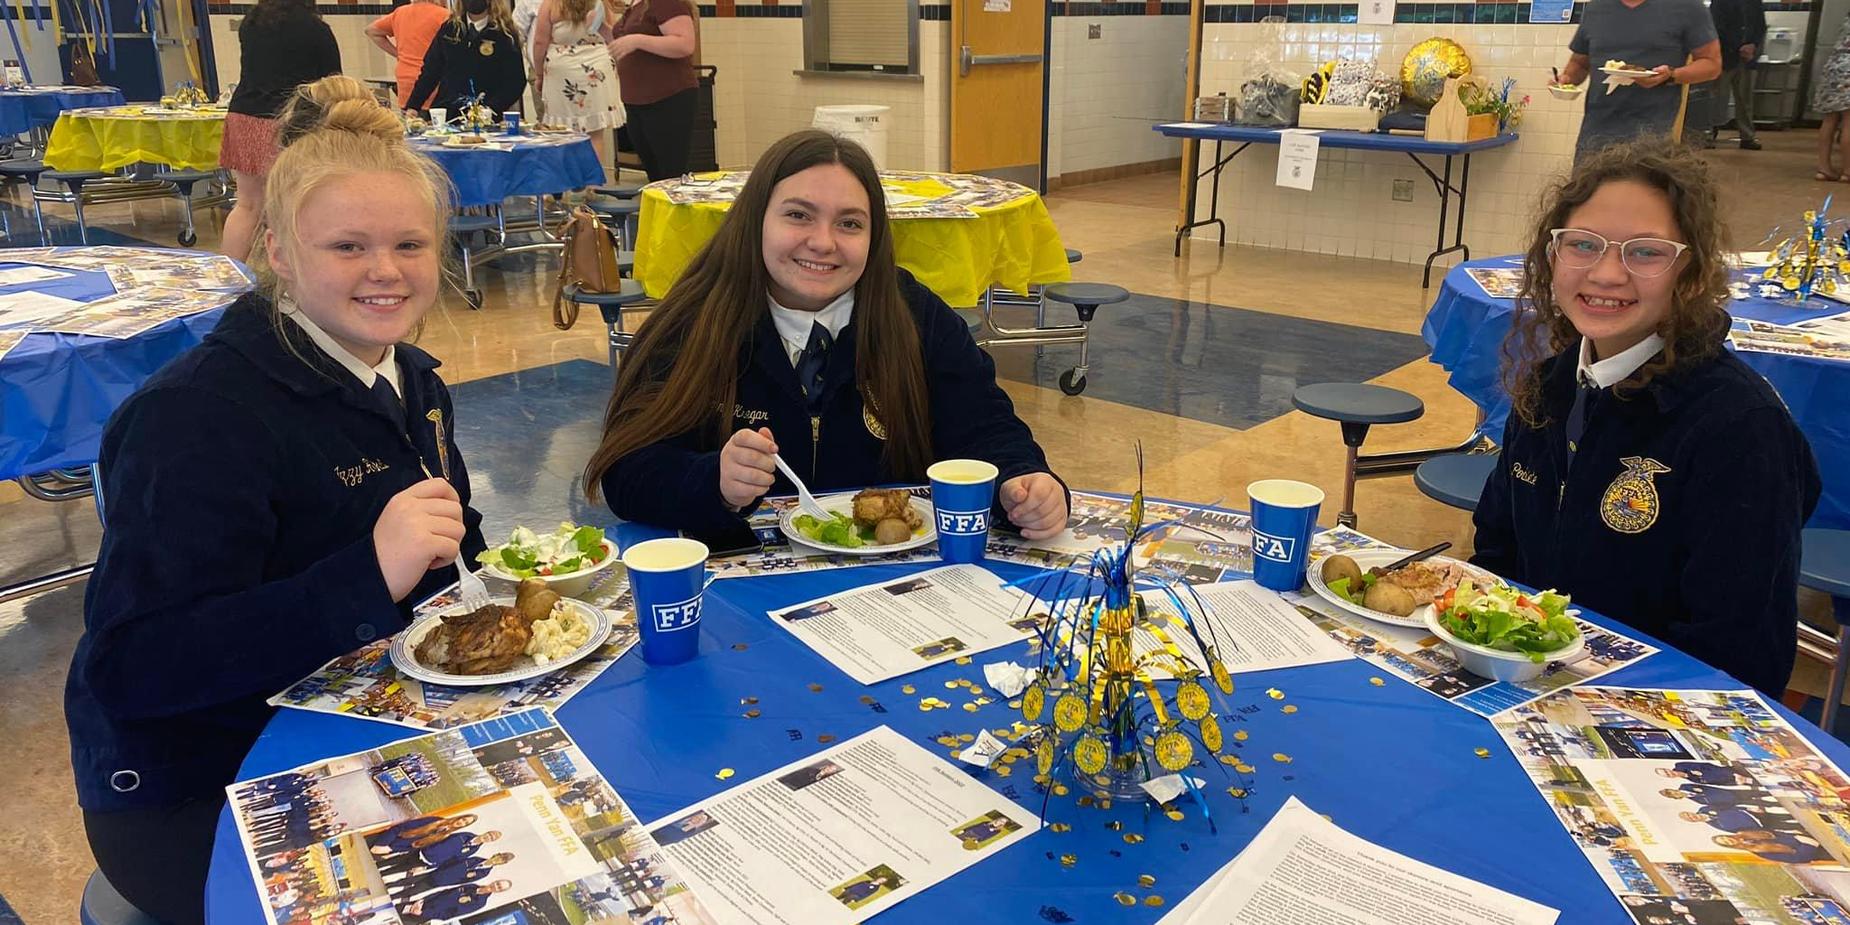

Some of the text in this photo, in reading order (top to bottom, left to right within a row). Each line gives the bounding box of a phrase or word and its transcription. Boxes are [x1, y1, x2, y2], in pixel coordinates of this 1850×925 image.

[1621, 487, 1639, 498] FFA
[940, 513, 986, 532] FFA
[1251, 530, 1287, 559] FA
[530, 794, 579, 856] Penn Yan FFA
